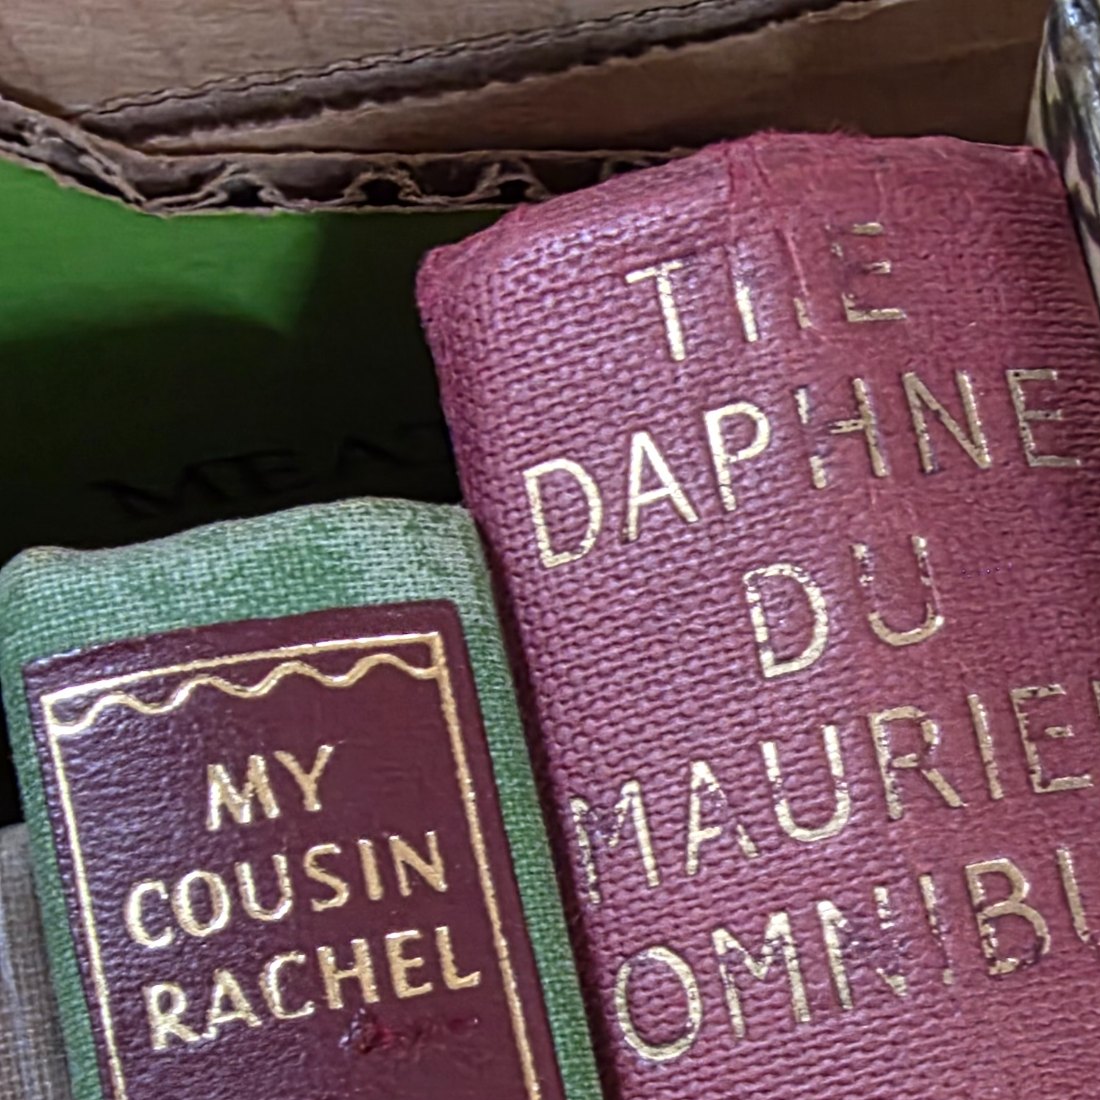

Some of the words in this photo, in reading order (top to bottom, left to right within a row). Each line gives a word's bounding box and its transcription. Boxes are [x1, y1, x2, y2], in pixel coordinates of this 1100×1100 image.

[625, 222, 906, 361] THE
[521, 369, 1081, 568] DAPHNE
[743, 535, 945, 678] DU
[206, 745, 335, 831] MY
[124, 831, 447, 948] COUSIN
[142, 926, 481, 1050] RACHEL
